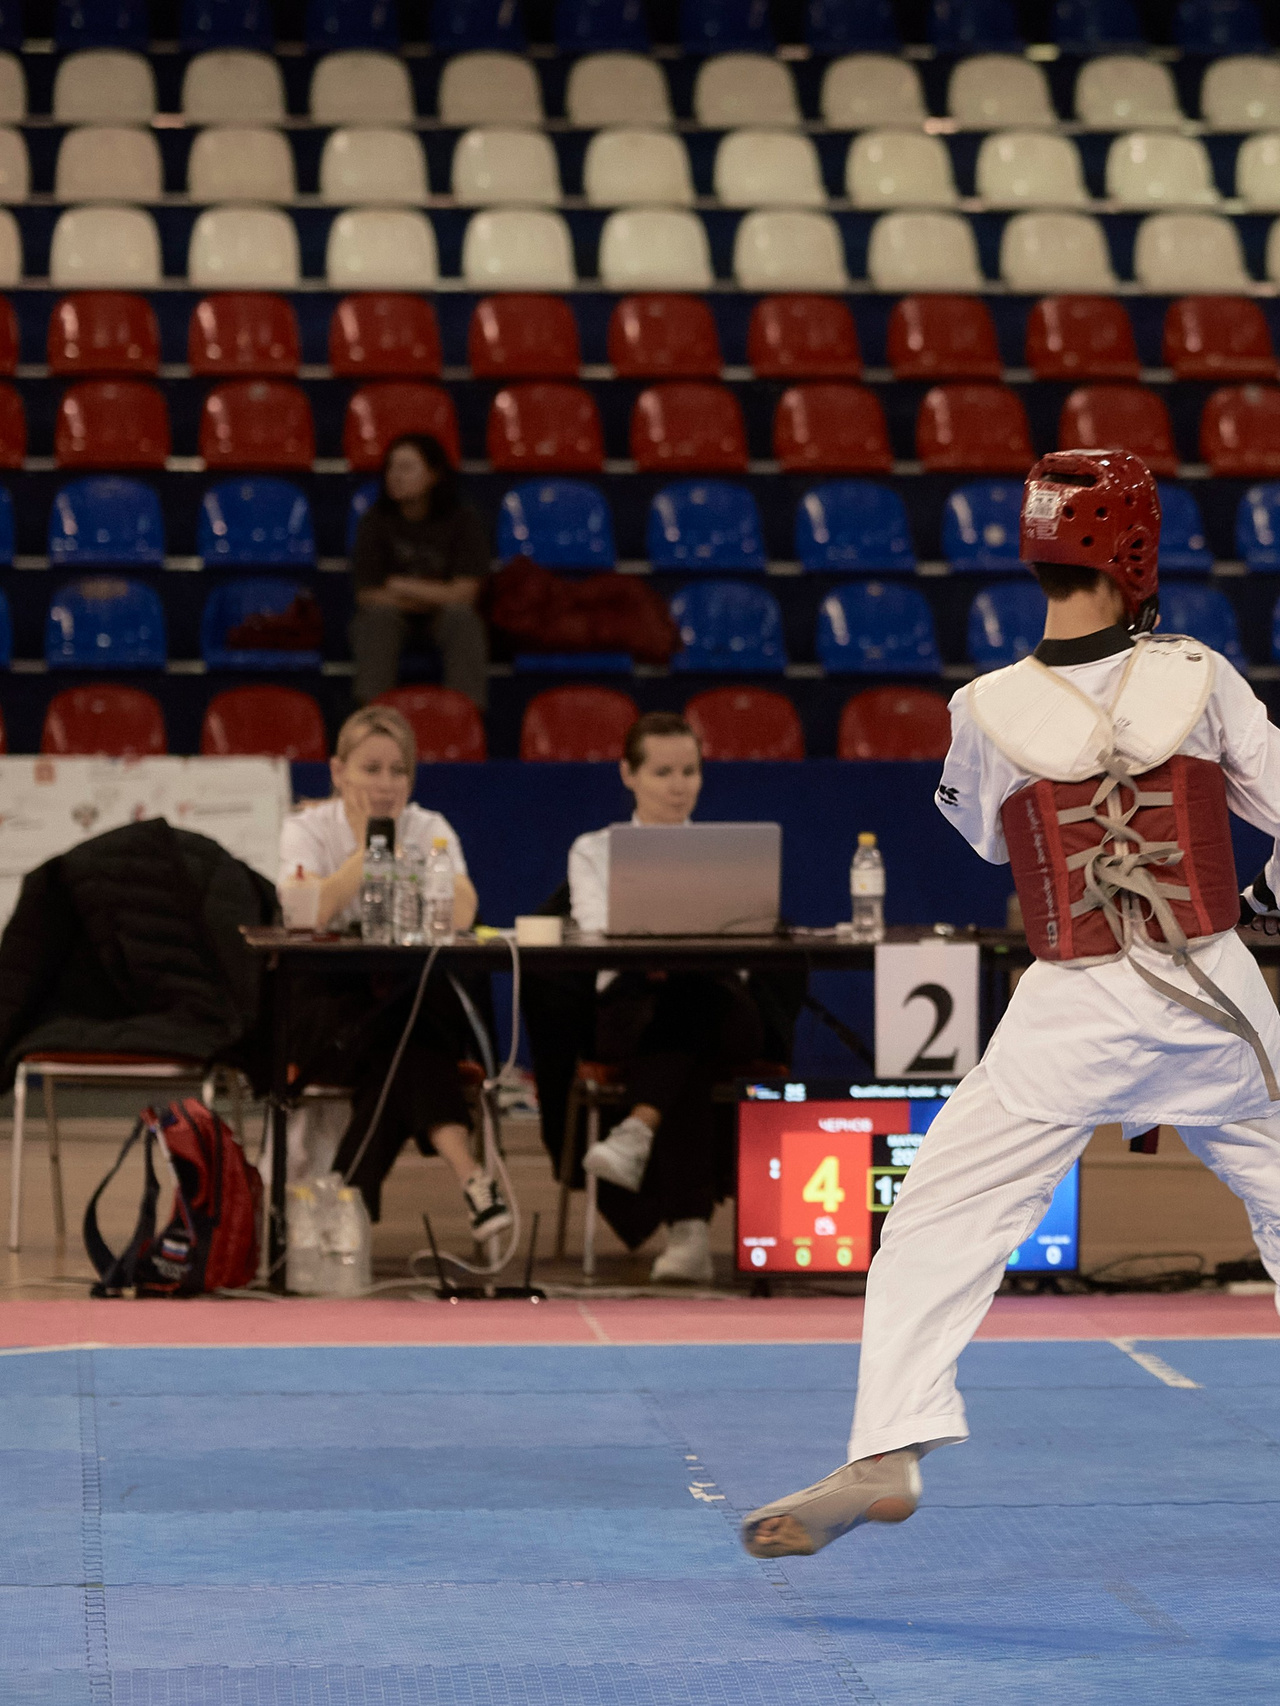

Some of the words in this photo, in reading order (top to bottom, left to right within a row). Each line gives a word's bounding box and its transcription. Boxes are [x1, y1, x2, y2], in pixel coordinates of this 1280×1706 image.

[903, 983, 960, 1072] 2
[802, 1155, 846, 1213] 4
[751, 1246, 767, 1267] 0
[795, 1246, 811, 1267] 0
[836, 1246, 852, 1267] 0
[1046, 1245, 1062, 1265] 0
